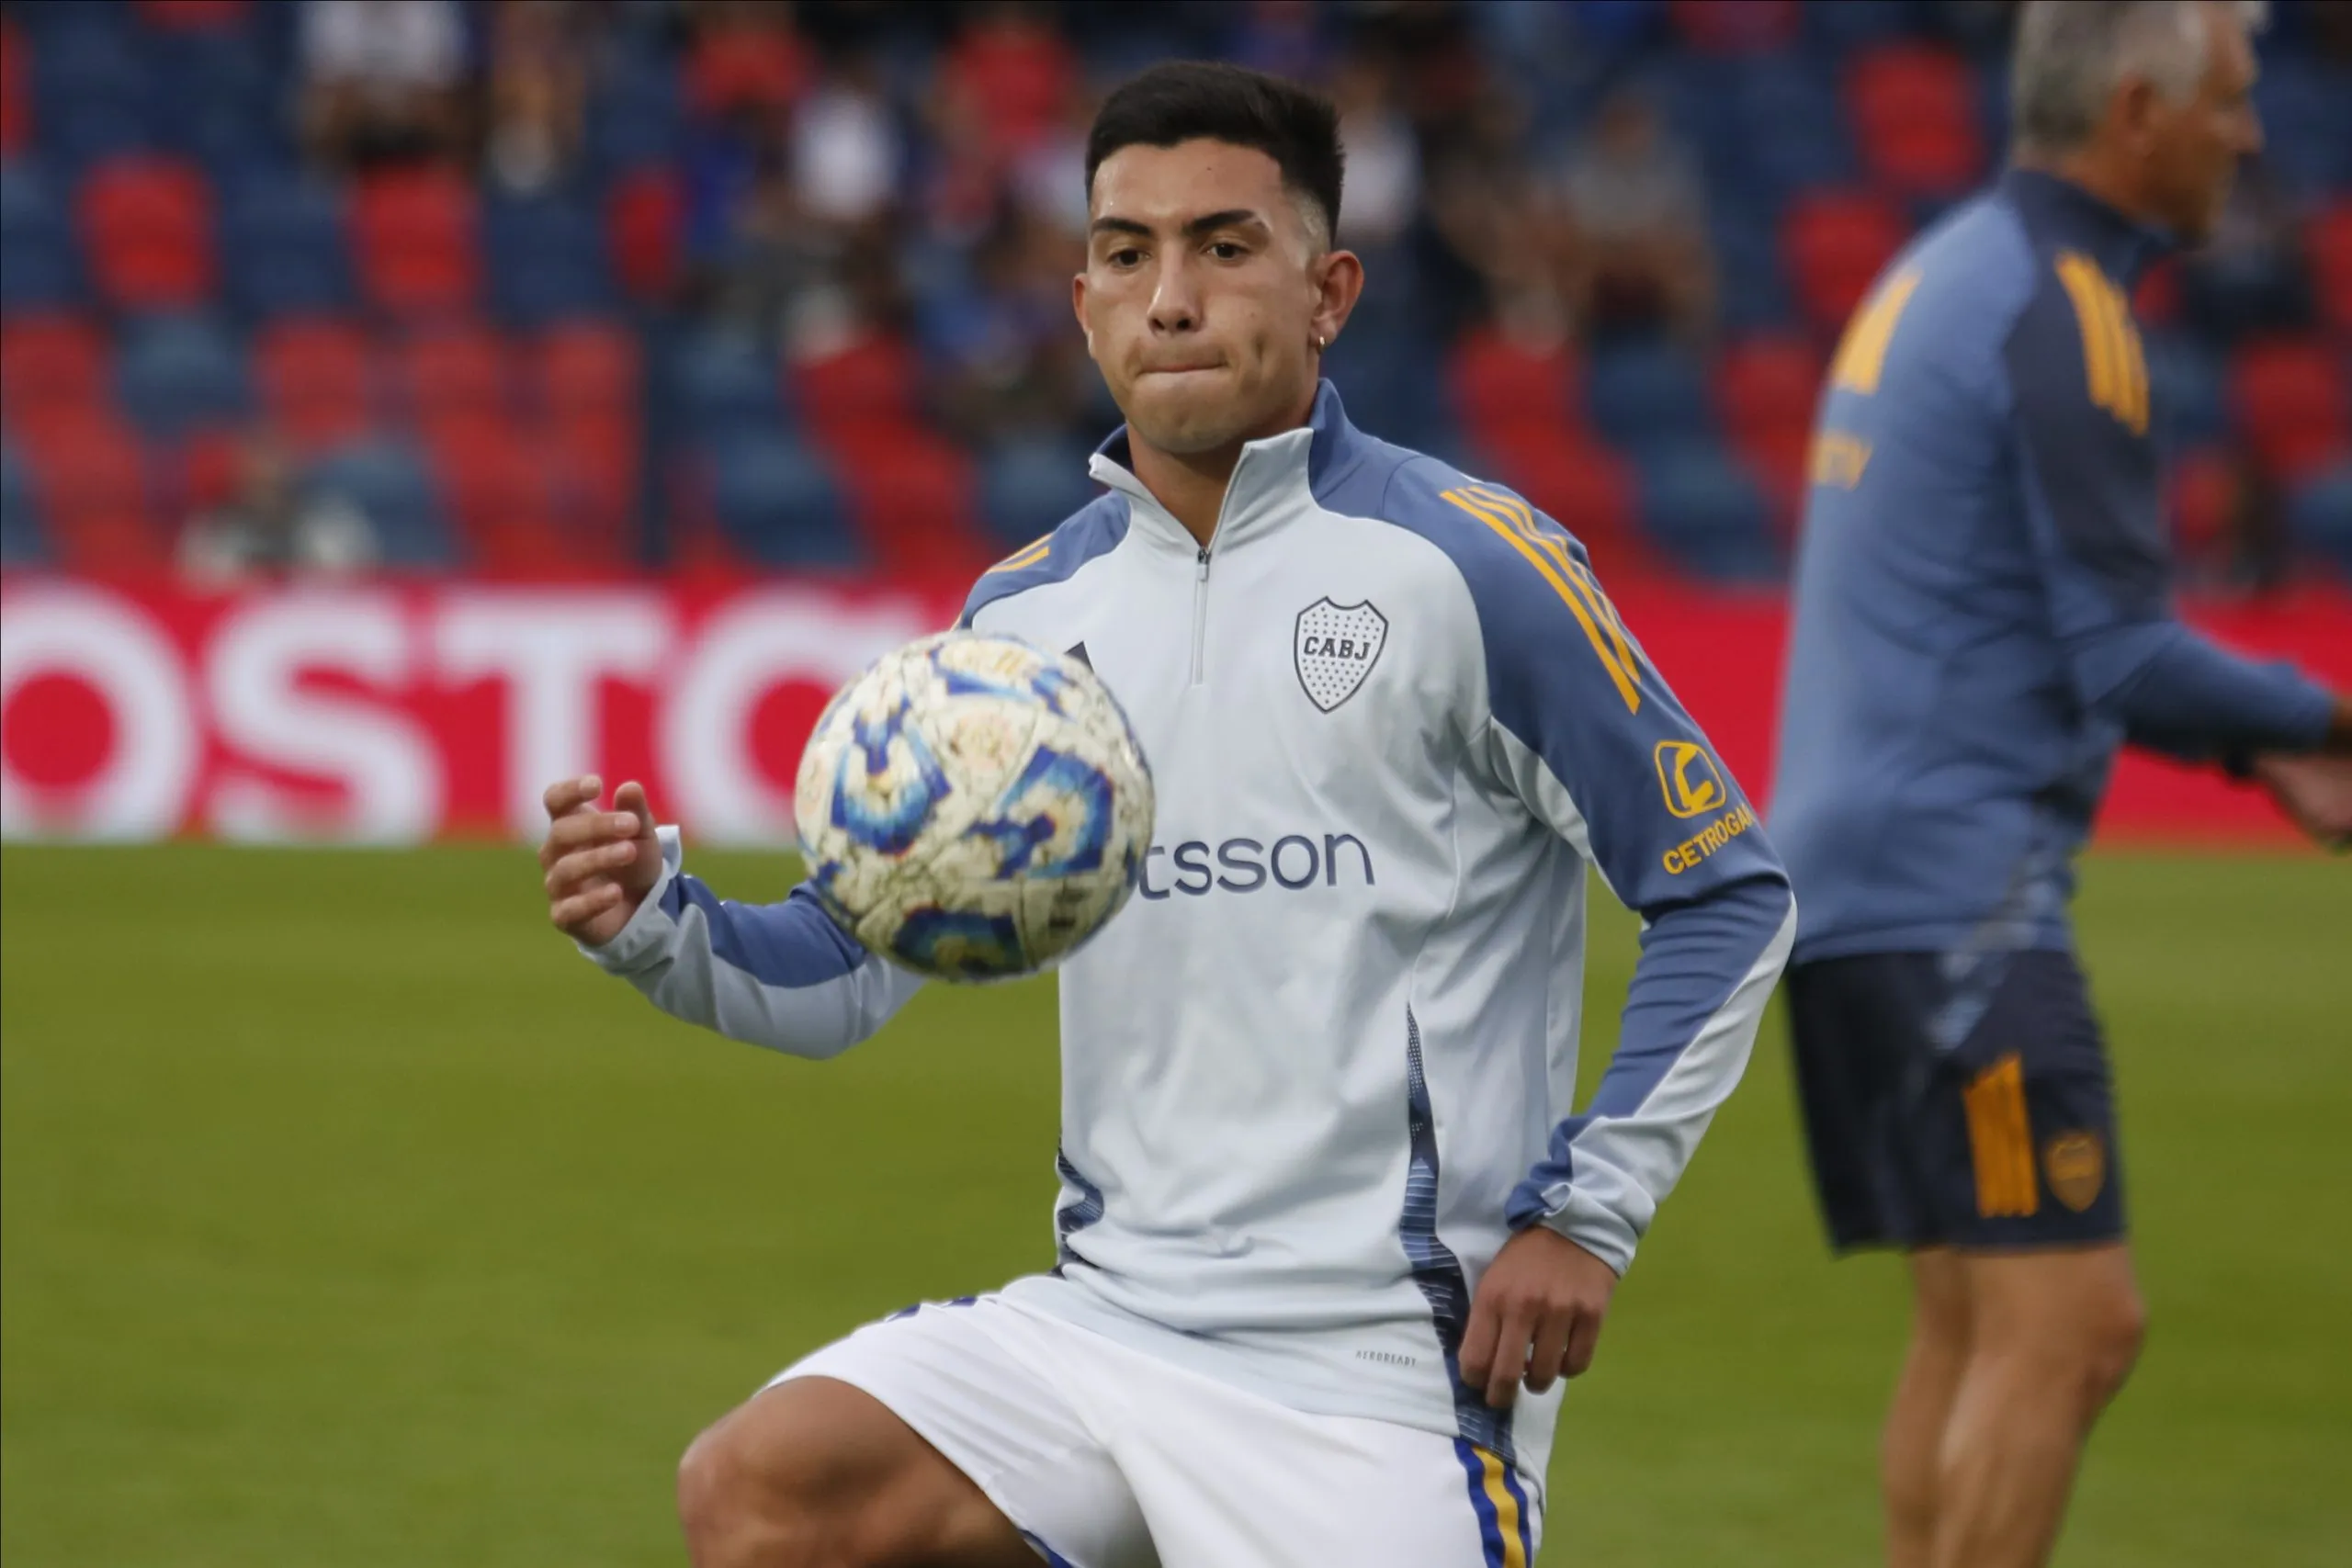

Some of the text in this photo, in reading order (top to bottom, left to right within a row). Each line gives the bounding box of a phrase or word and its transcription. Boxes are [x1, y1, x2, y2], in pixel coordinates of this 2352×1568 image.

[1304, 636, 1371, 660] CABJ
[1662, 802, 1754, 874] CETROGA
[1138, 833, 1375, 900] tsson
[1355, 1349, 1417, 1367] AEROREADY
